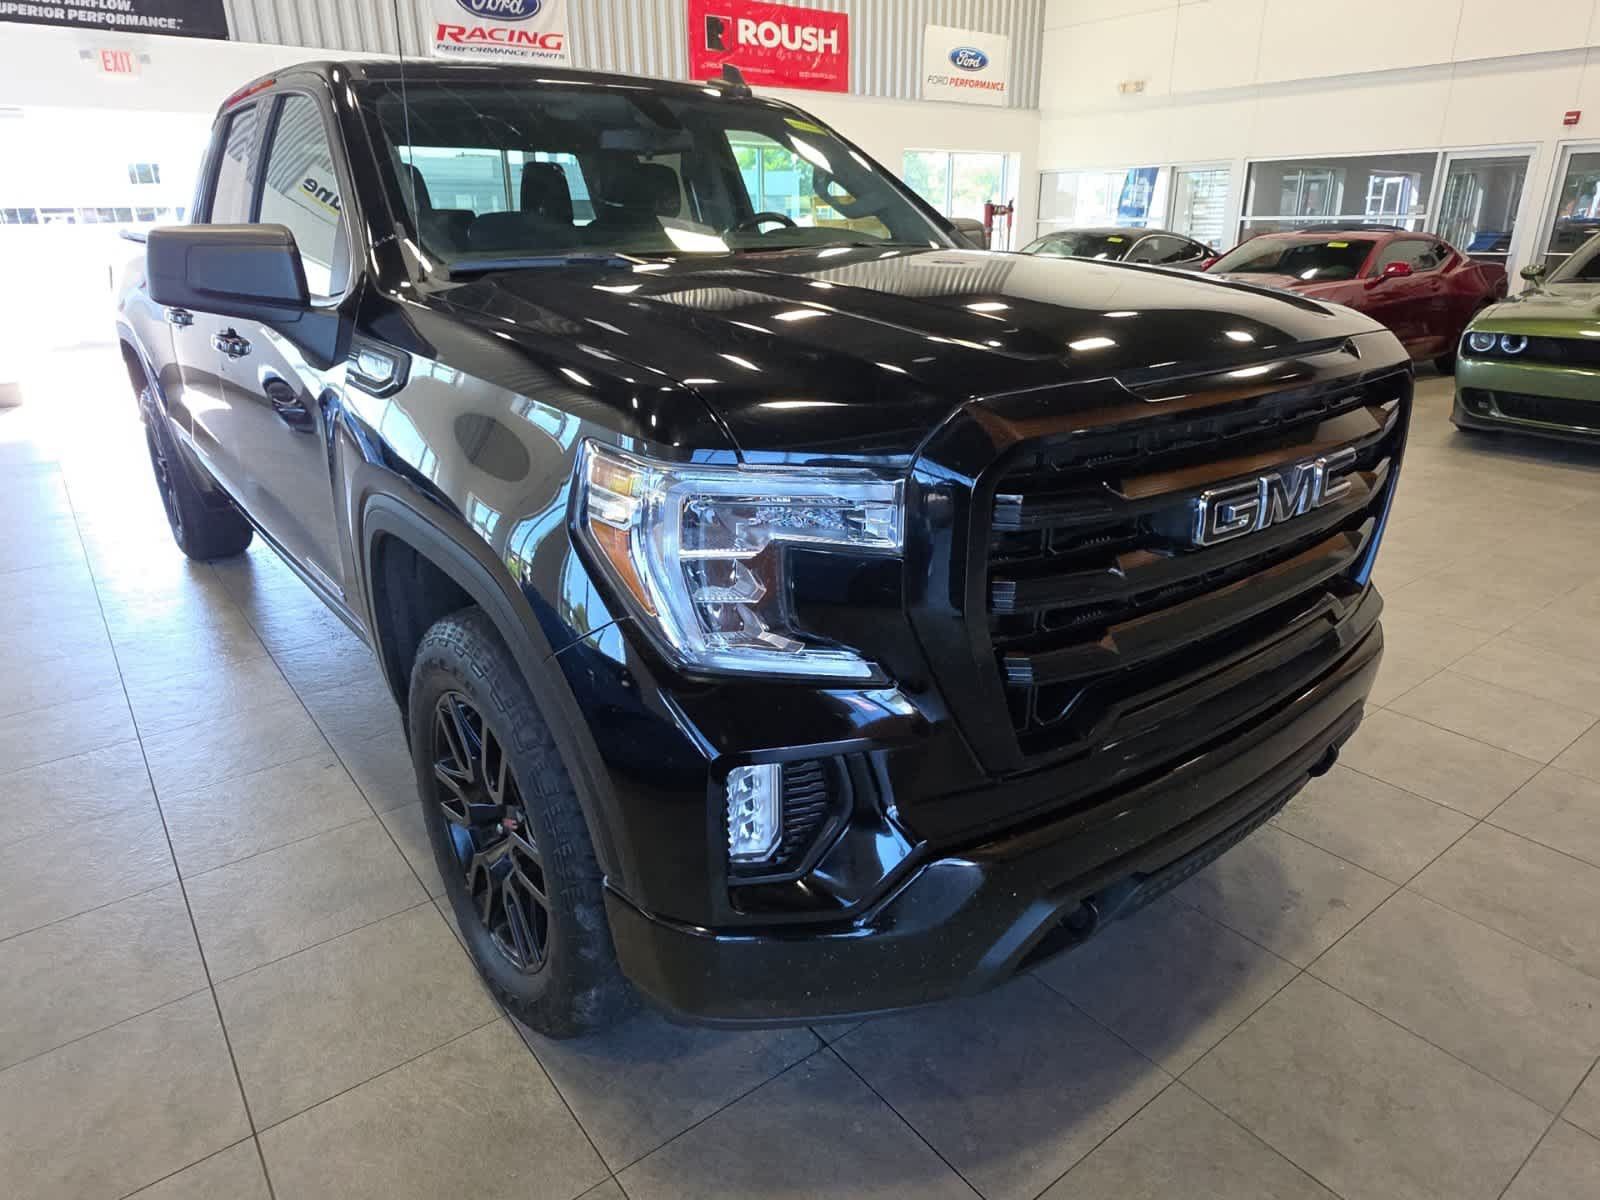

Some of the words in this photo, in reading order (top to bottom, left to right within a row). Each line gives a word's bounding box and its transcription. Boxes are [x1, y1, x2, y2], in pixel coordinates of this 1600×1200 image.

[436, 23, 564, 51] RACING
[737, 18, 838, 55] ROUSH
[101, 50, 132, 72] EXIT
[436, 43, 530, 57] PERFORMANCE
[531, 52, 565, 60] PARTS
[956, 49, 982, 67] Ford
[927, 75, 948, 85] FORD
[949, 77, 1005, 91] PERFORMANCE
[1192, 447, 1357, 547] GMC
